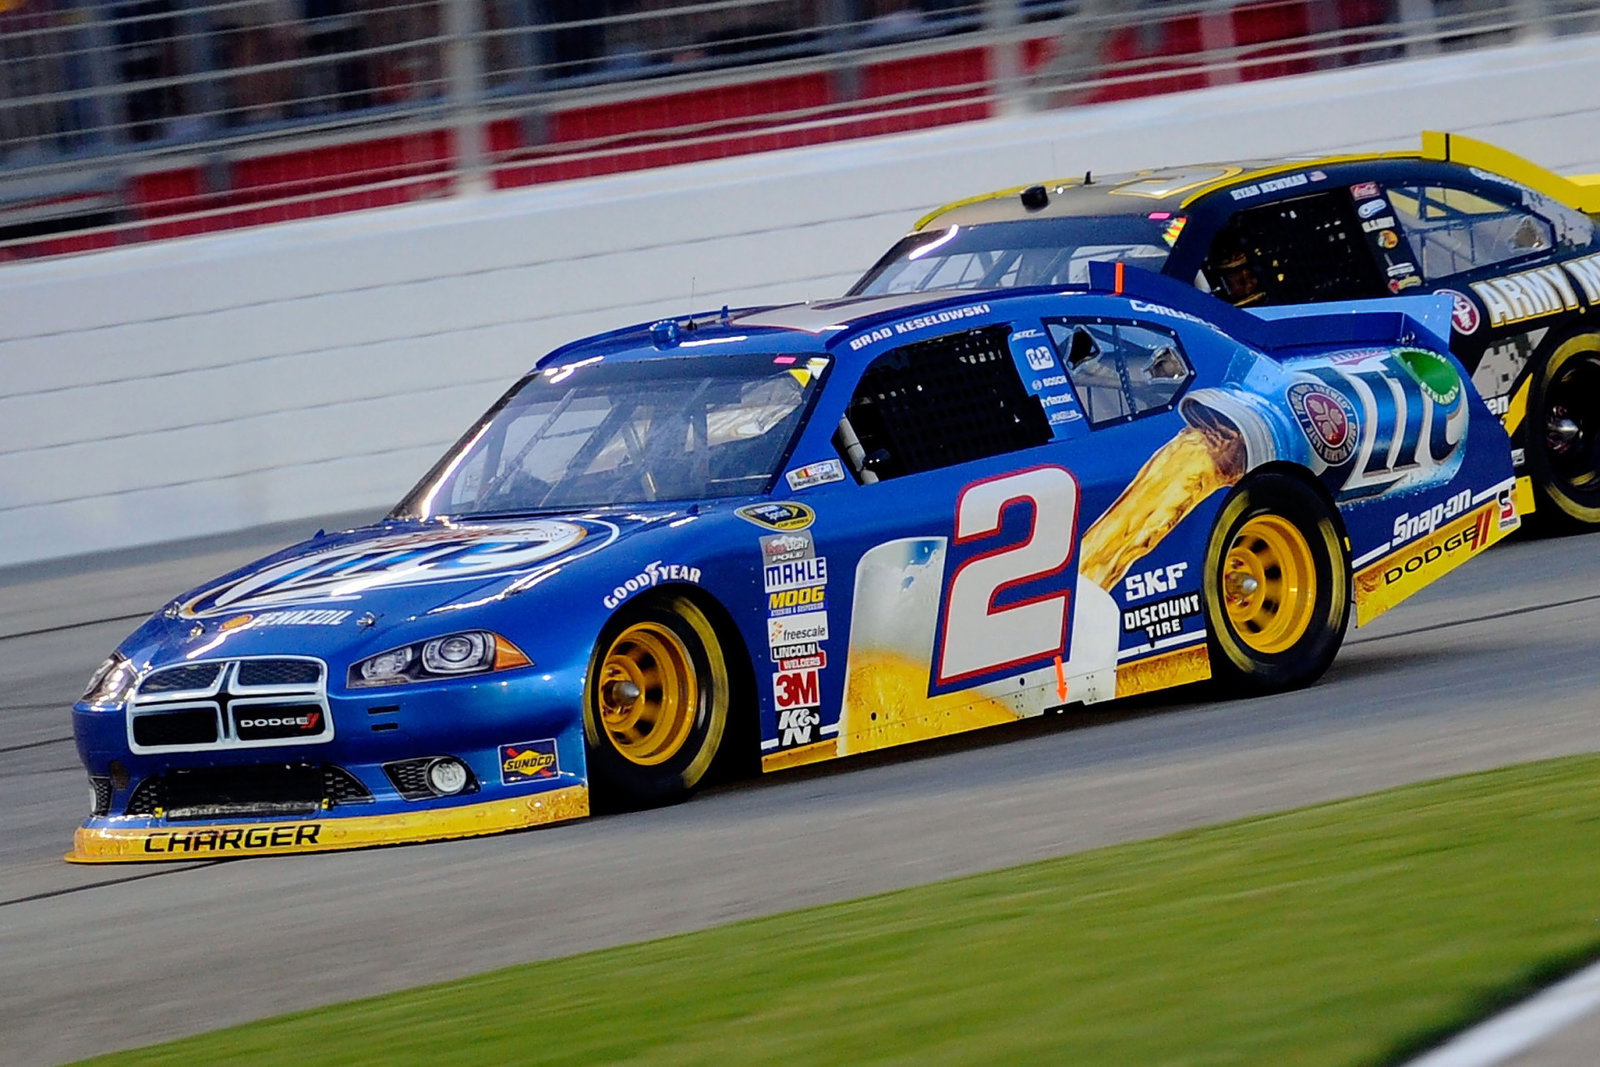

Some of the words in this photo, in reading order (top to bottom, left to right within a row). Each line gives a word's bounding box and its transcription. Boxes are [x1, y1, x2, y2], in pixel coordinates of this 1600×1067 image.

[1468, 263, 1580, 328] ARMY
[849, 327, 893, 351] BRAD
[895, 303, 991, 334] KESELOWSKI
[1420, 381, 1460, 405] ETHANOL
[1391, 488, 1472, 547] Snap-on
[1384, 524, 1480, 586] DODGE
[603, 561, 702, 609] GOODYEAR
[765, 558, 825, 587] MAHLE
[937, 463, 1081, 686] 2
[1125, 562, 1188, 602] SKF
[769, 586, 825, 610] MOOG
[1124, 594, 1199, 630] DISCOUNT
[256, 609, 354, 627] PENNZOIL
[1145, 618, 1181, 639] TIRE
[783, 626, 826, 641] freescale
[773, 643, 816, 660] LINCOLN
[776, 671, 818, 707] 3M
[240, 717, 310, 728] DODGE
[506, 755, 553, 770] SUNOCO
[143, 824, 322, 853] CHARGER
